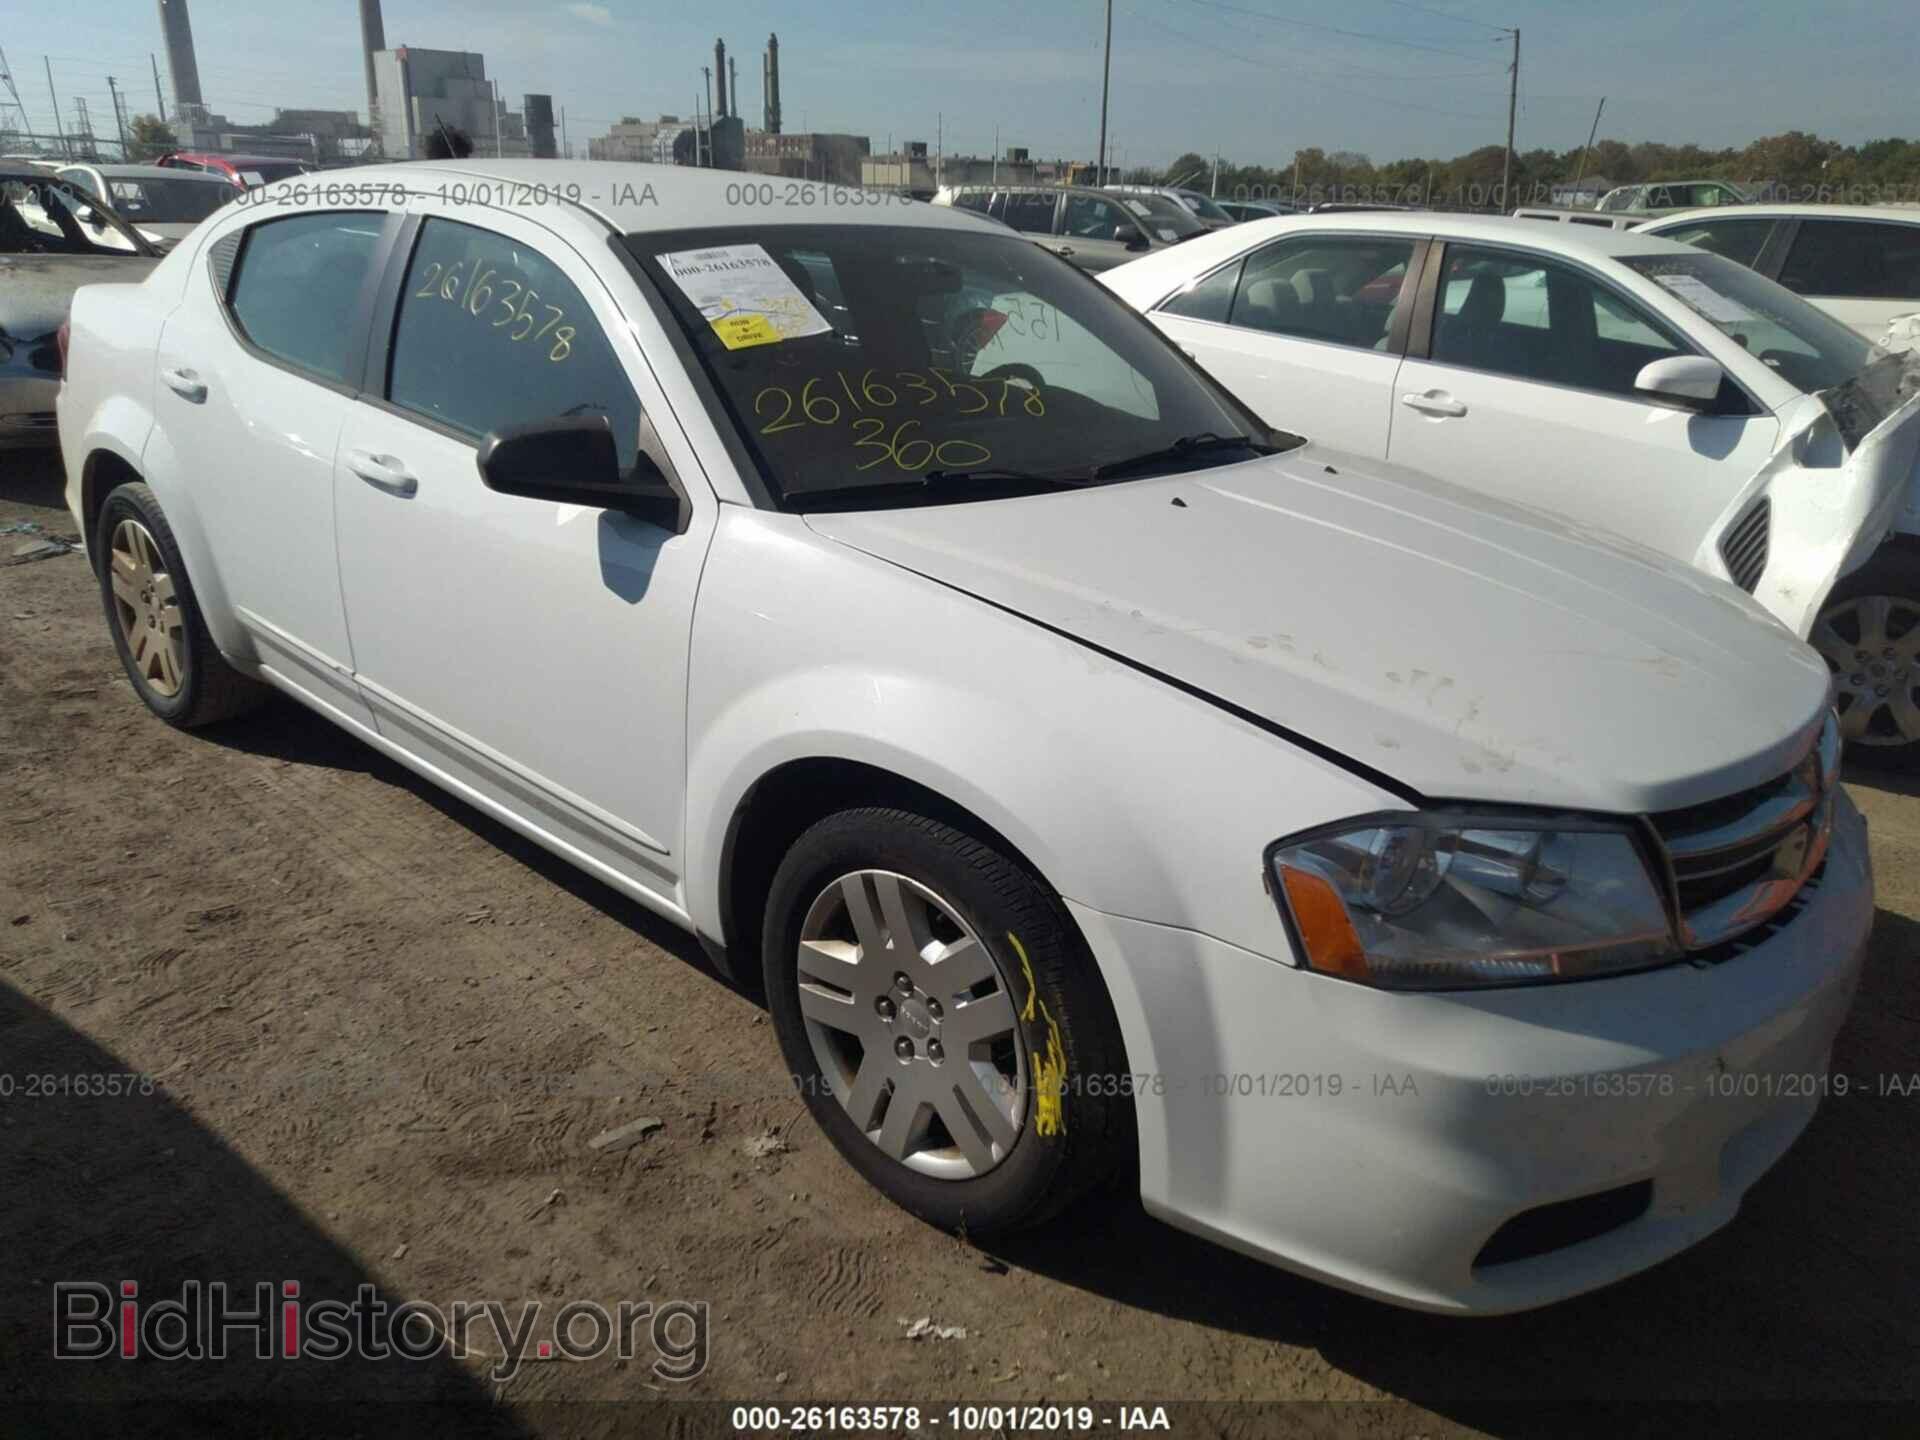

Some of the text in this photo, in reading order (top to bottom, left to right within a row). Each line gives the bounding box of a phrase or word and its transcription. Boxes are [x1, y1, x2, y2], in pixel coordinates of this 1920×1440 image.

[415, 257, 577, 362] 26163578
[755, 367, 1045, 433] 26163578
[852, 418, 991, 471] 360
